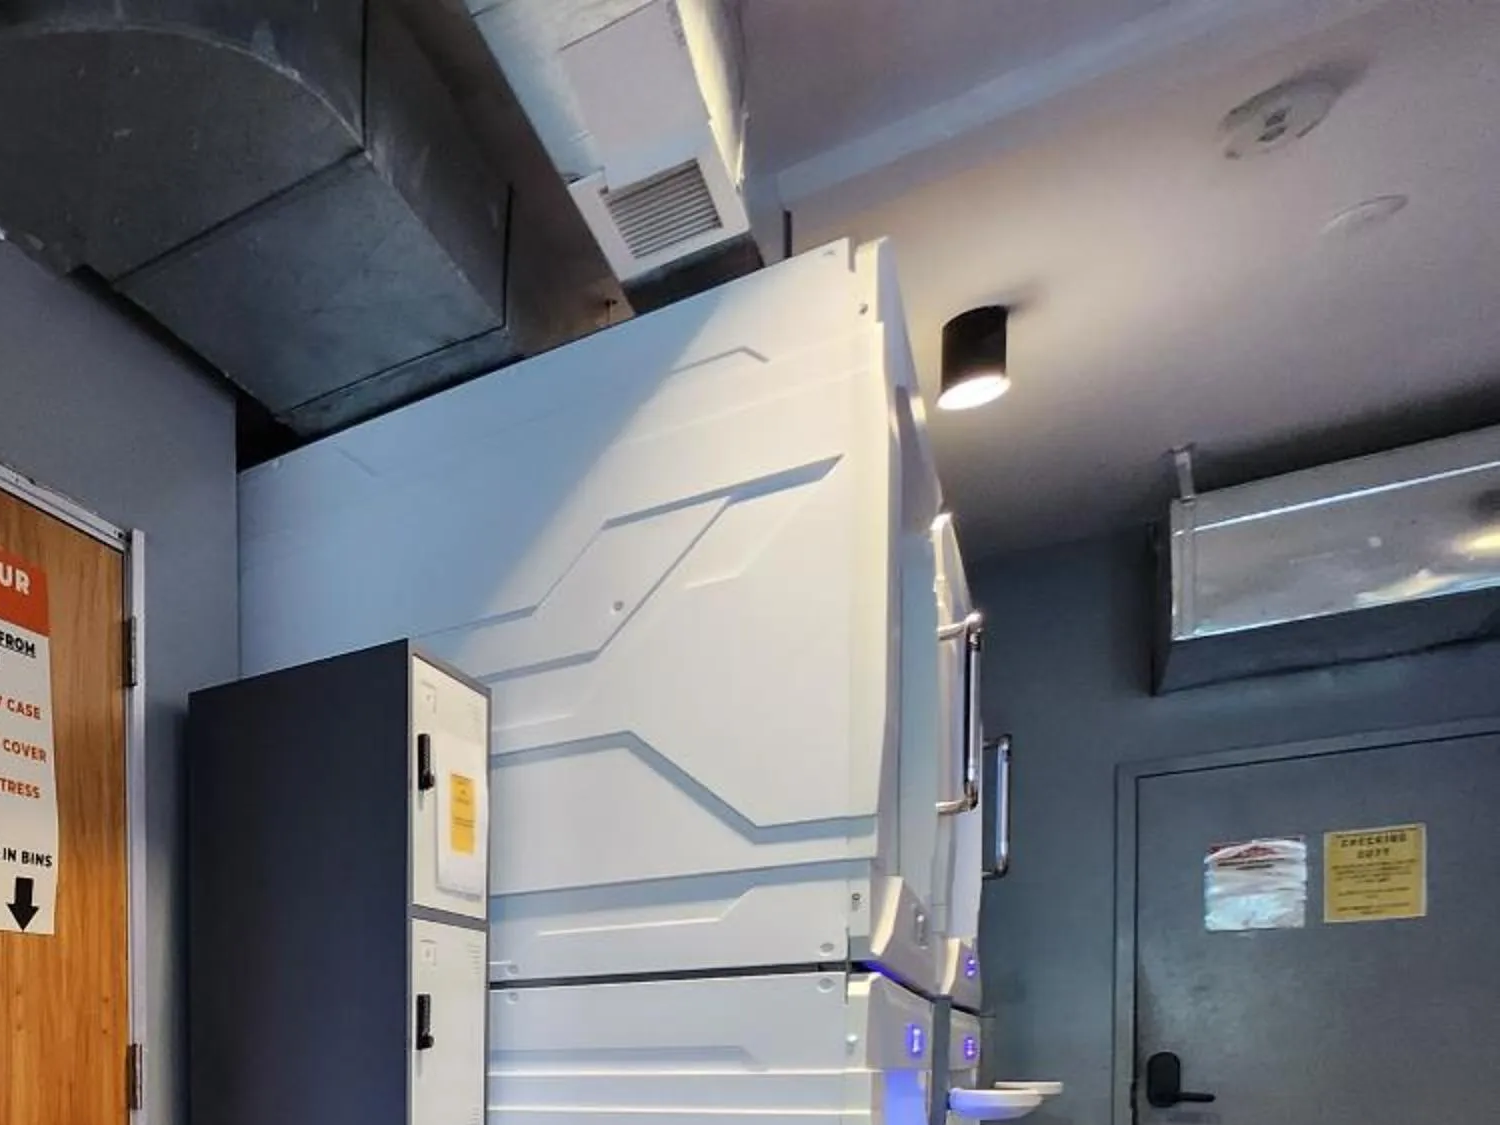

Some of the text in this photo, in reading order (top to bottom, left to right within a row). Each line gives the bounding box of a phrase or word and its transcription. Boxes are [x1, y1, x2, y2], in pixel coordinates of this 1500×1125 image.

[6, 698, 41, 720] CASE
[2, 738, 47, 763] COVER
[2, 847, 17, 863] IN
[21, 850, 53, 868] BINS
